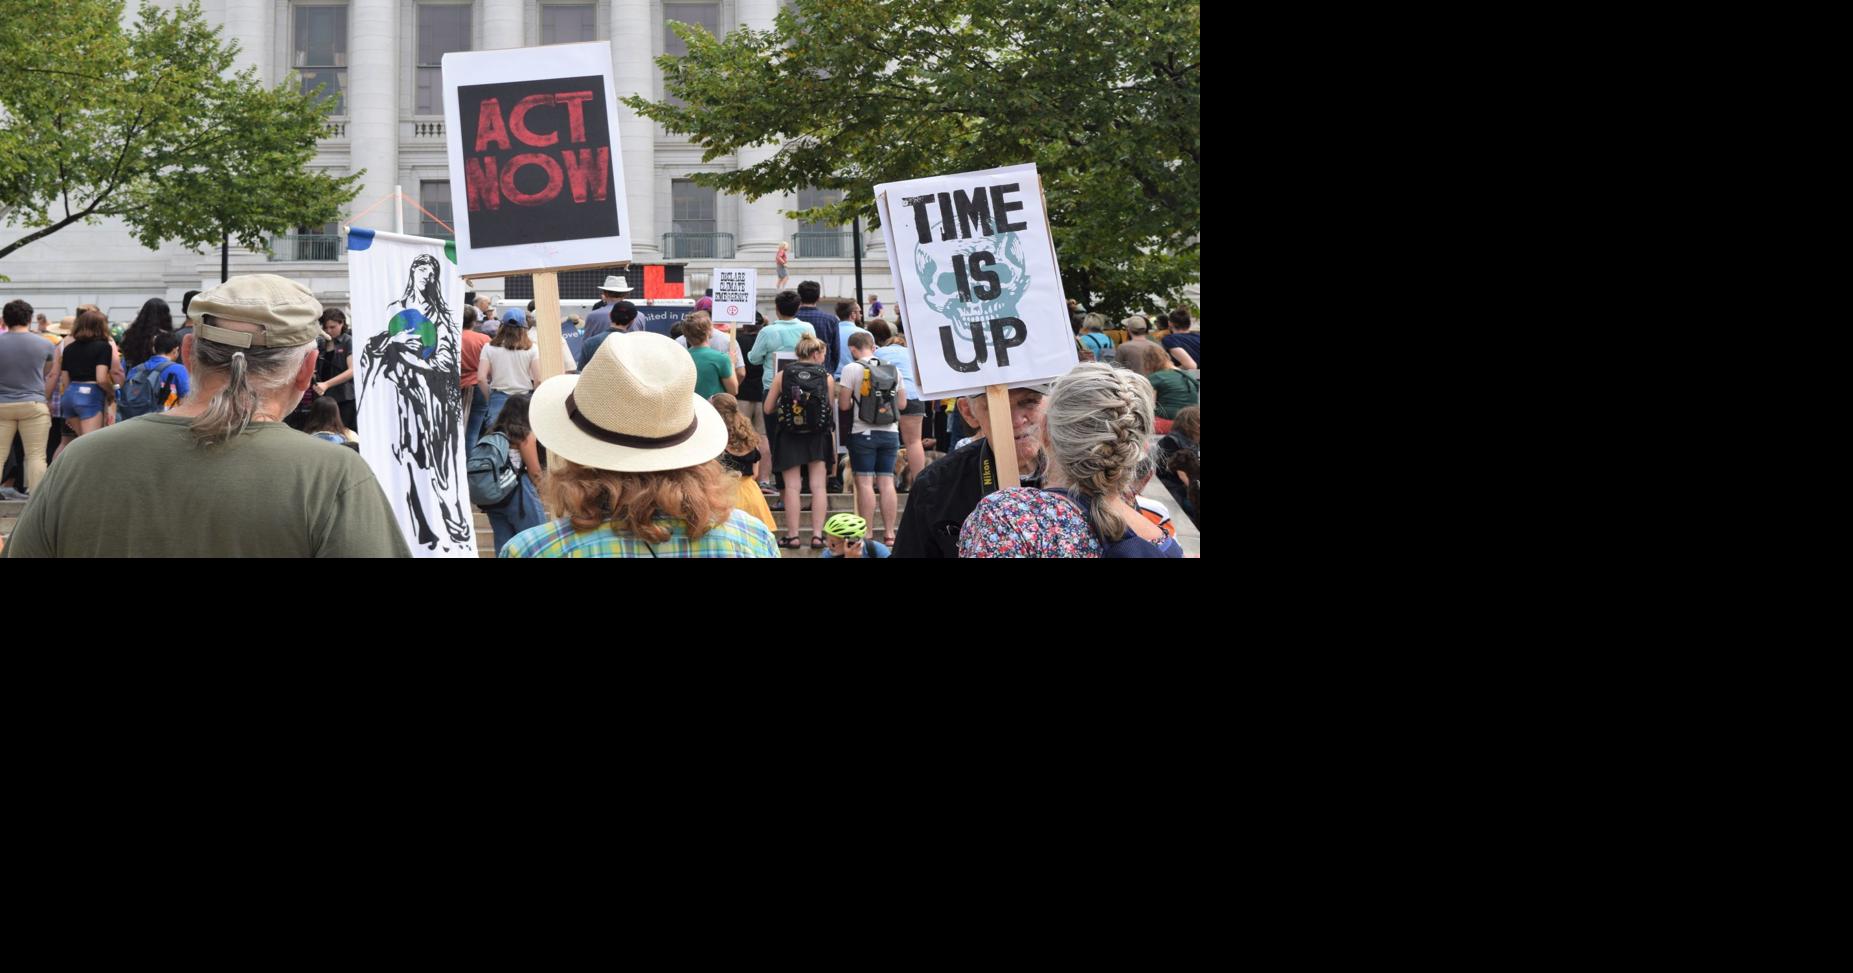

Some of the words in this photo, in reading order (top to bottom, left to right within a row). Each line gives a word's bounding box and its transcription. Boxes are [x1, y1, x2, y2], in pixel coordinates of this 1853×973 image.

[475, 90, 593, 152] ACT
[466, 146, 609, 212] NOW
[902, 183, 1027, 244] TIME
[719, 282, 746, 292] CLIMATE
[720, 271, 746, 282] DECLARE
[952, 251, 1001, 303] IS
[644, 311, 667, 321] nited
[670, 311, 679, 320] in
[714, 292, 749, 303] EMERGENCY
[938, 317, 1028, 373] UP
[983, 459, 992, 486] Nikon
